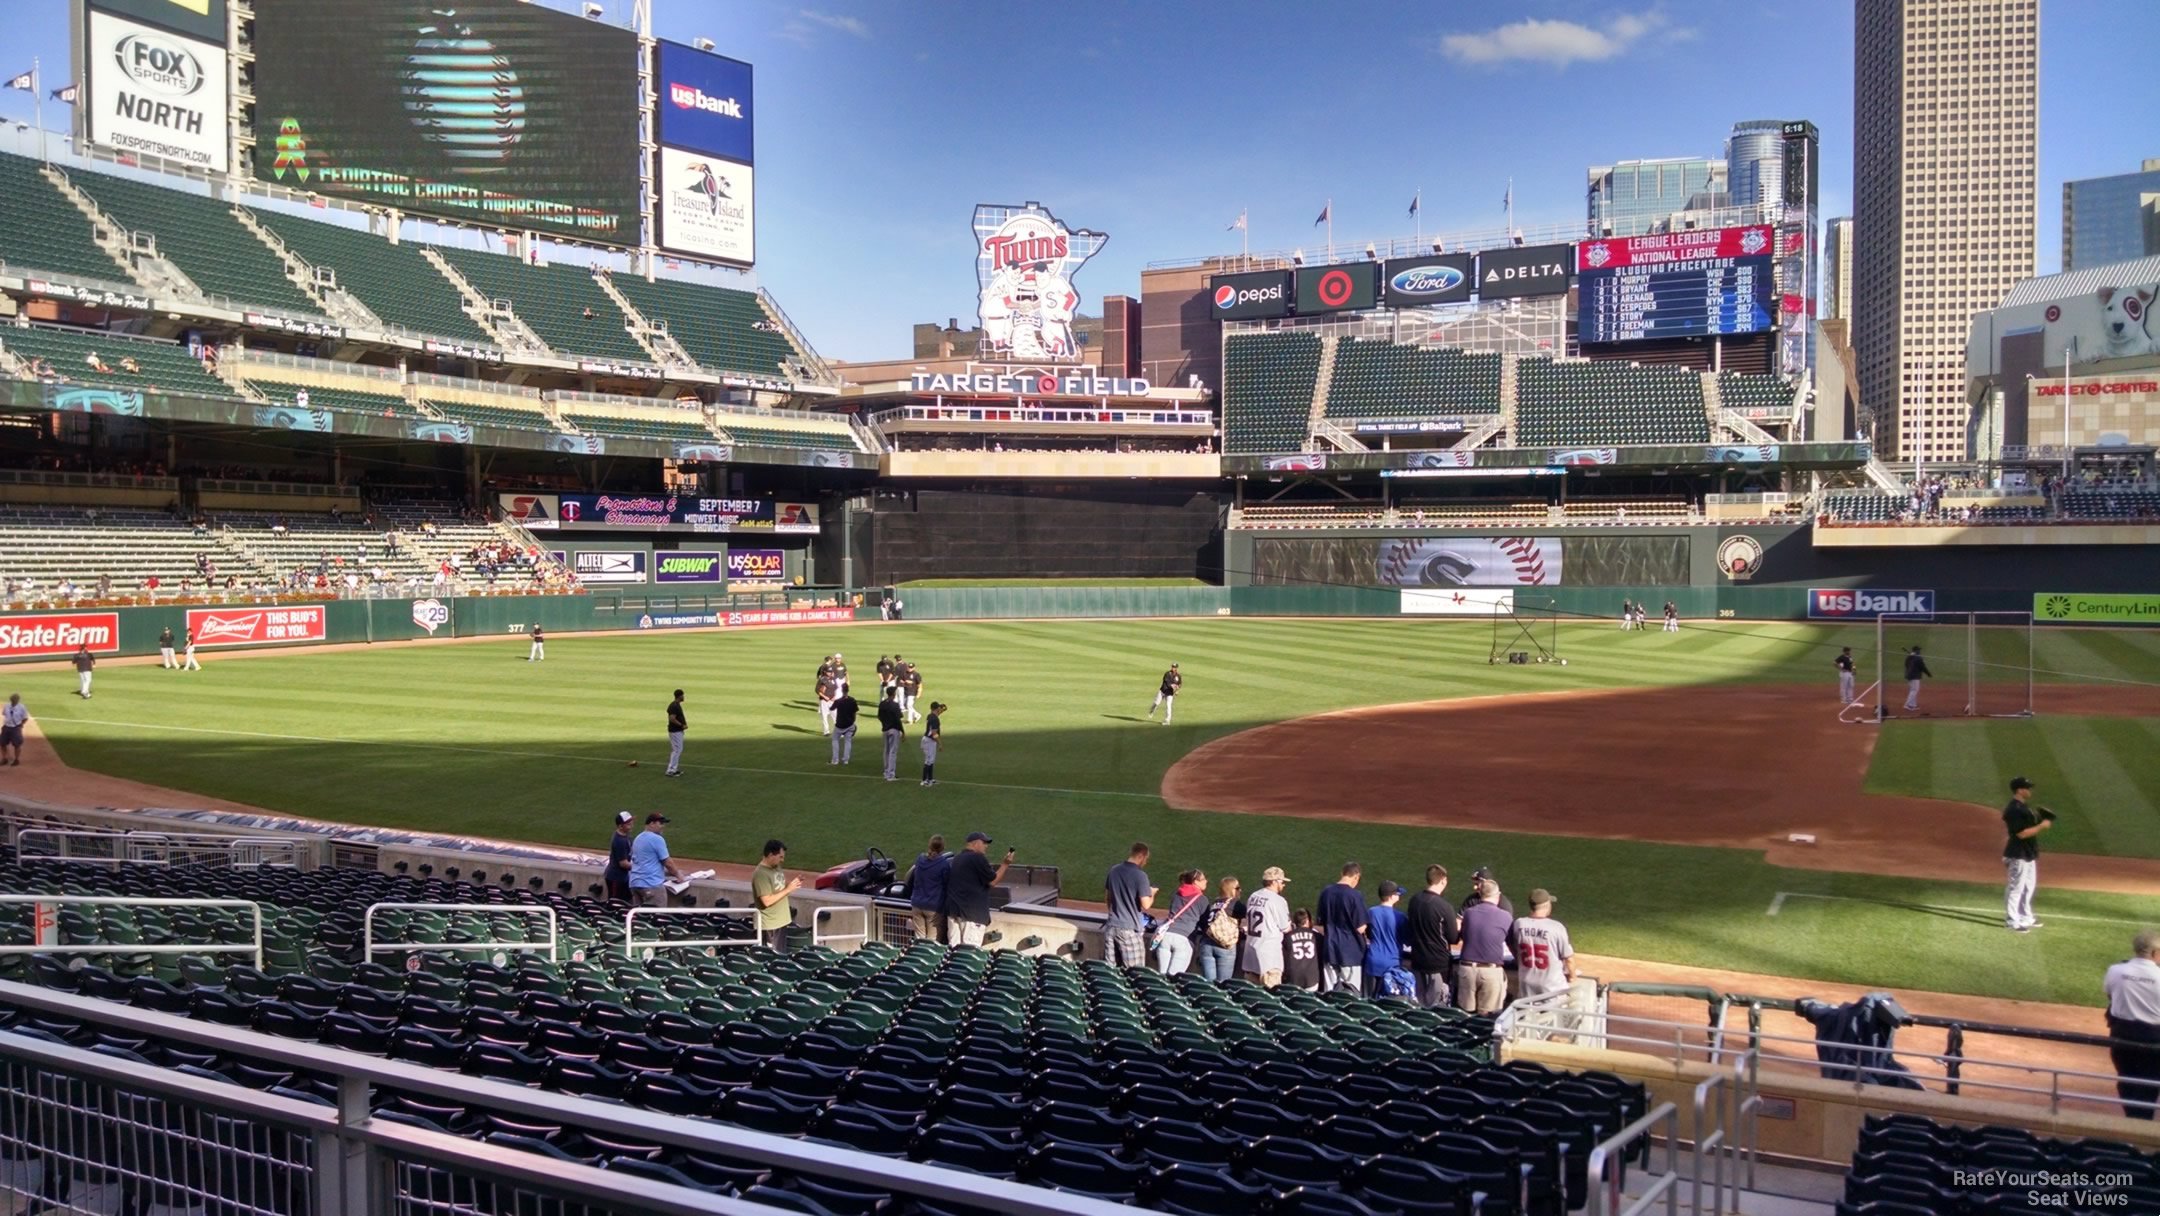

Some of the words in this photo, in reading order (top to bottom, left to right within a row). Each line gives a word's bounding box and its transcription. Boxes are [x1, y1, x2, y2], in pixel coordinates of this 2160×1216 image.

[134, 41, 185, 78] FOX
[134, 66, 187, 89] SPORTS
[116, 91, 204, 135] NORTH
[1784, 123, 1803, 133] 5:18
[111, 132, 211, 164] FOXSPORTSNORTH.COM
[672, 190, 709, 212] Treasure
[719, 200, 745, 220] Island
[1628, 235, 1669, 250] LEAGUE
[1670, 230, 1721, 247] LEADERS
[984, 231, 1068, 271] Twins
[1631, 250, 1678, 264] NATIONAL
[1681, 246, 1718, 260] LEAGUE
[1504, 263, 1564, 280] DELTA
[1615, 263, 1665, 276] SLUGGING
[1667, 257, 1735, 272] PERCENTAGE
[1404, 268, 1449, 291] Ford
[1600, 278, 1604, 286] 1
[1612, 277, 1618, 286] D
[1620, 275, 1650, 285] MURPHY
[1706, 268, 1724, 277] WSH
[1238, 283, 1283, 304] pepsi
[1612, 286, 1618, 294] K
[1620, 284, 1649, 294] BRYANT
[1707, 278, 1723, 287] CHC
[77, 287, 102, 302] Home
[104, 292, 123, 306] Run
[124, 295, 149, 309] Porch
[1599, 296, 1604, 304] 3
[1612, 295, 1618, 303] N
[1620, 292, 1654, 302] ARENADO
[1707, 288, 1722, 296] COL
[1599, 305, 1604, 313] 4
[1612, 304, 1618, 312] Y
[1620, 301, 1657, 311] CESPEDES
[1706, 296, 1724, 305] NYM
[1612, 313, 1617, 321] T
[1620, 312, 1644, 321] STORY
[1707, 306, 1722, 315] COL
[284, 319, 305, 332] Home
[305, 322, 321, 335] Run
[322, 324, 341, 338] Porch
[1599, 323, 1604, 331] 6
[1612, 322, 1617, 330] F
[1620, 320, 1655, 330] FREEMAN
[1707, 316, 1722, 324] ATL
[1599, 333, 1604, 341] 7
[1612, 332, 1617, 340] R
[1620, 330, 1644, 340] BRAUN
[1707, 325, 1722, 334] MIL
[911, 373, 1034, 393] TARGET
[1065, 377, 1151, 396] FIELD
[2102, 381, 2158, 394] CENTER
[1429, 422, 1461, 431] Ballpark
[595, 495, 664, 511] Promotions
[666, 497, 678, 512] &
[699, 499, 752, 512] SEPTEMBER
[754, 500, 760, 513] 7
[605, 510, 670, 531] Giveaways
[684, 513, 716, 523] MIDWEST
[718, 514, 740, 525] MUSIC
[693, 523, 731, 533] SHOWCASE
[658, 557, 718, 574] SUBWAY
[266, 611, 289, 624] THIS
[290, 610, 317, 623] BUD'S
[429, 607, 446, 622] 29
[729, 612, 741, 624] 25
[742, 613, 761, 624] YEARS
[761, 613, 769, 622] OF
[769, 612, 788, 622] GIVING
[789, 611, 802, 621] KIDS
[802, 611, 807, 620] A
[807, 611, 828, 620] CHANCE
[829, 610, 836, 619] TO
[1719, 609, 1735, 617] 365
[2077, 601, 2160, 617] CenturyLin
[202, 620, 254, 633] Budweiser
[508, 624, 525, 633] 377
[654, 617, 672, 625] TWINS
[673, 616, 703, 624] COMMUNITY
[703, 615, 717, 623] FUND
[266, 625, 286, 638] FOR
[287, 624, 308, 637] YOU.
[40, 907, 55, 928] 14
[1247, 910, 1264, 938] 12
[1518, 927, 1549, 940] THOME
[1292, 941, 1315, 960] 53
[1518, 943, 1549, 970] 25
